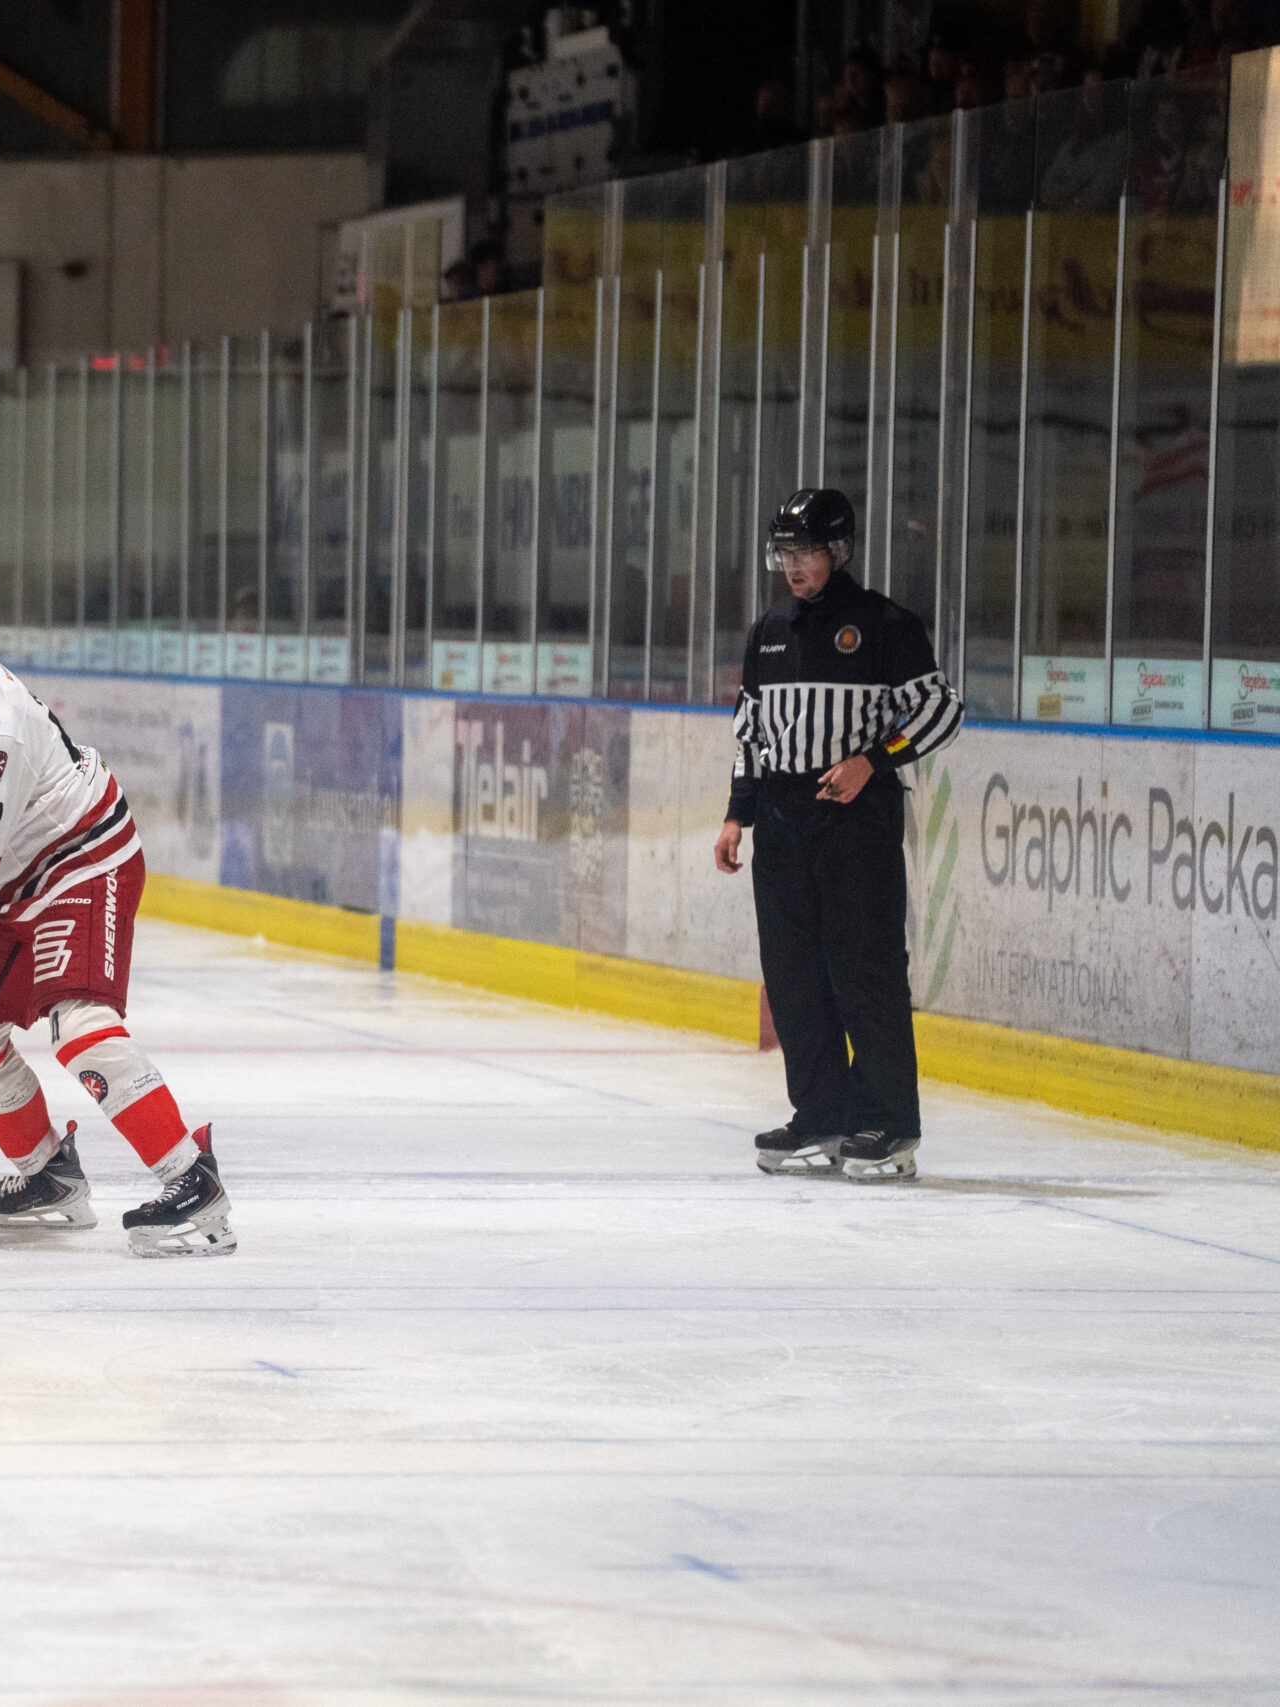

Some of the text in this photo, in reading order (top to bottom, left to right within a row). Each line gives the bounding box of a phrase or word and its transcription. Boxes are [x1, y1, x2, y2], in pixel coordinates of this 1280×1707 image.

[980, 772, 1279, 920] Graphic Packa
[977, 950, 1132, 1016] INTERNATIONAL
